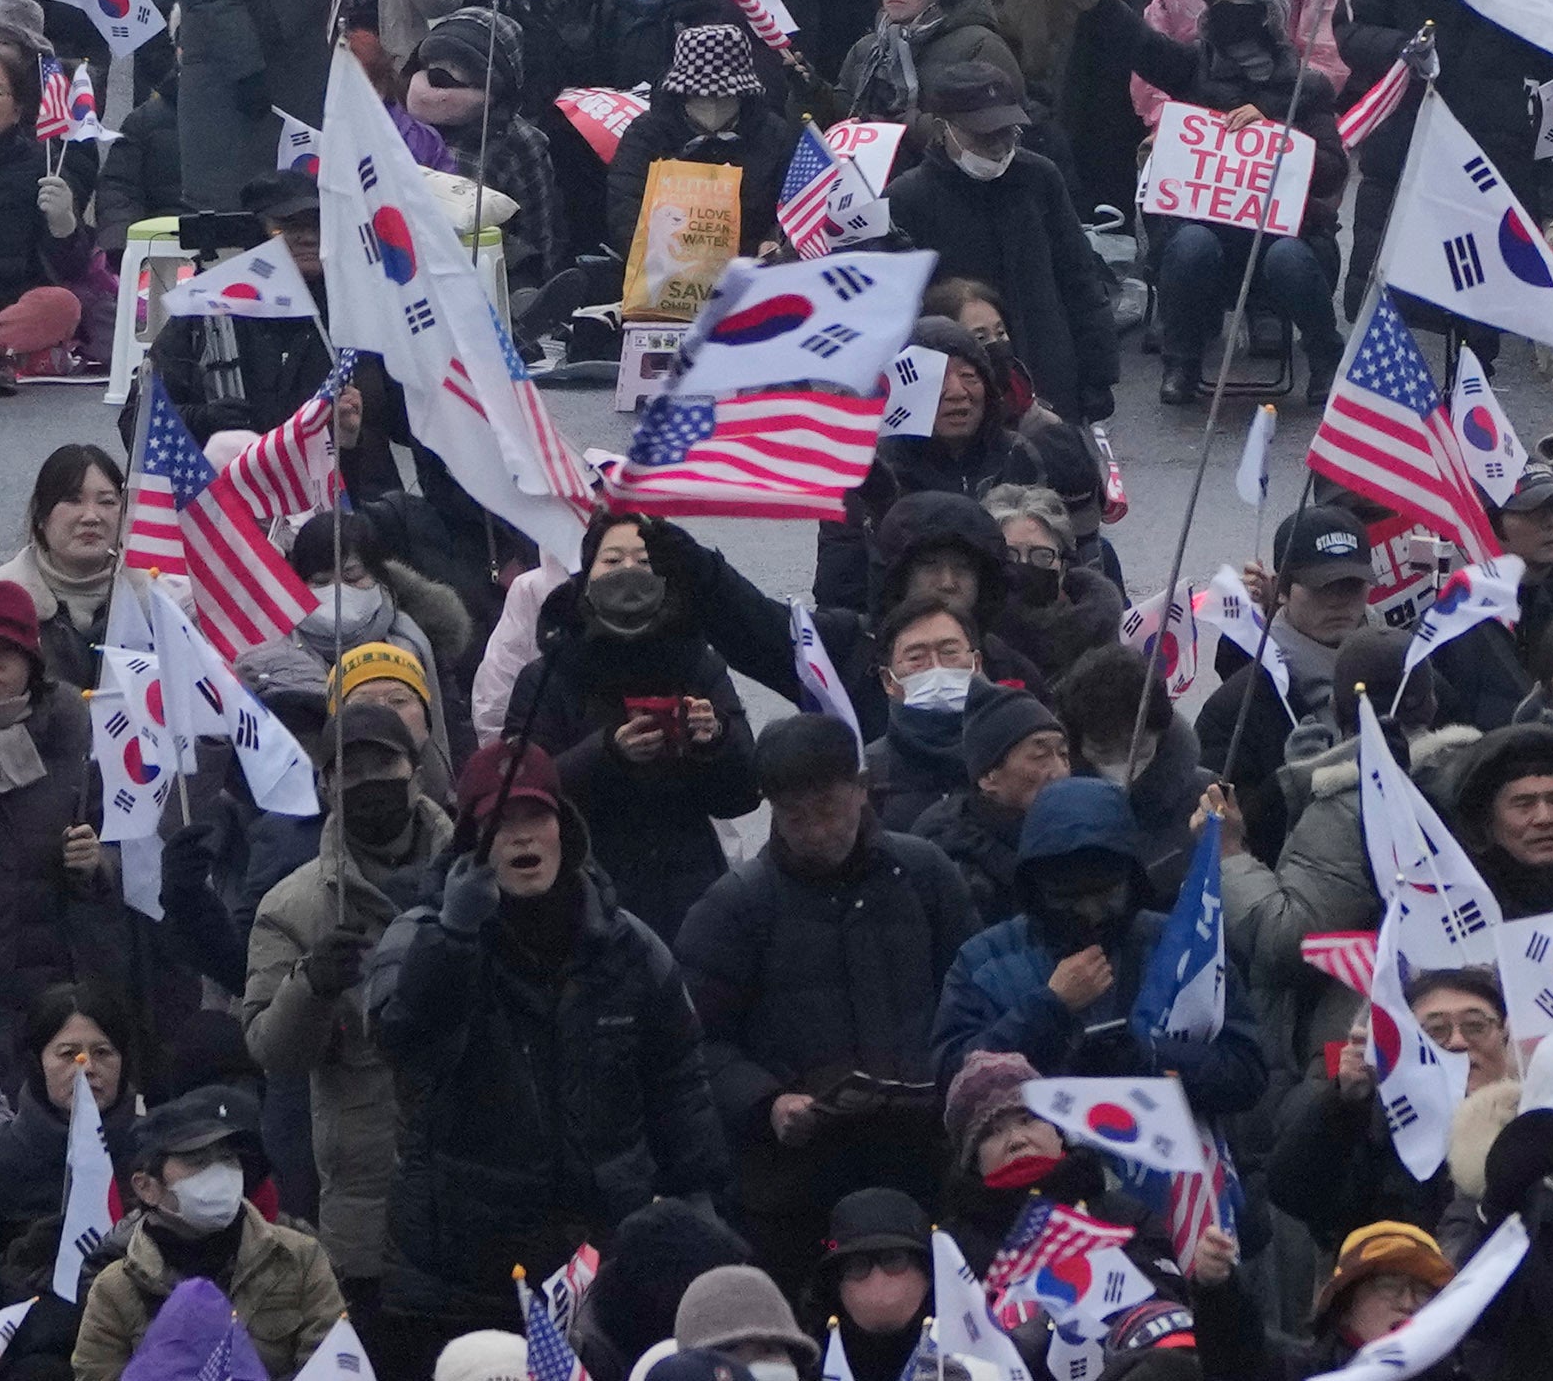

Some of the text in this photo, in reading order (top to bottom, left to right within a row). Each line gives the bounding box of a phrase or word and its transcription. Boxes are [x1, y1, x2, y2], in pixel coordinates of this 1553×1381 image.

[1178, 113, 1294, 159] STOP
[1189, 148, 1274, 183] THE
[697, 208, 731, 219] LOVE
[1154, 176, 1290, 232] STEAL
[689, 220, 731, 234] CLEAN
[682, 233, 731, 248] WATER
[667, 280, 712, 301] SAV
